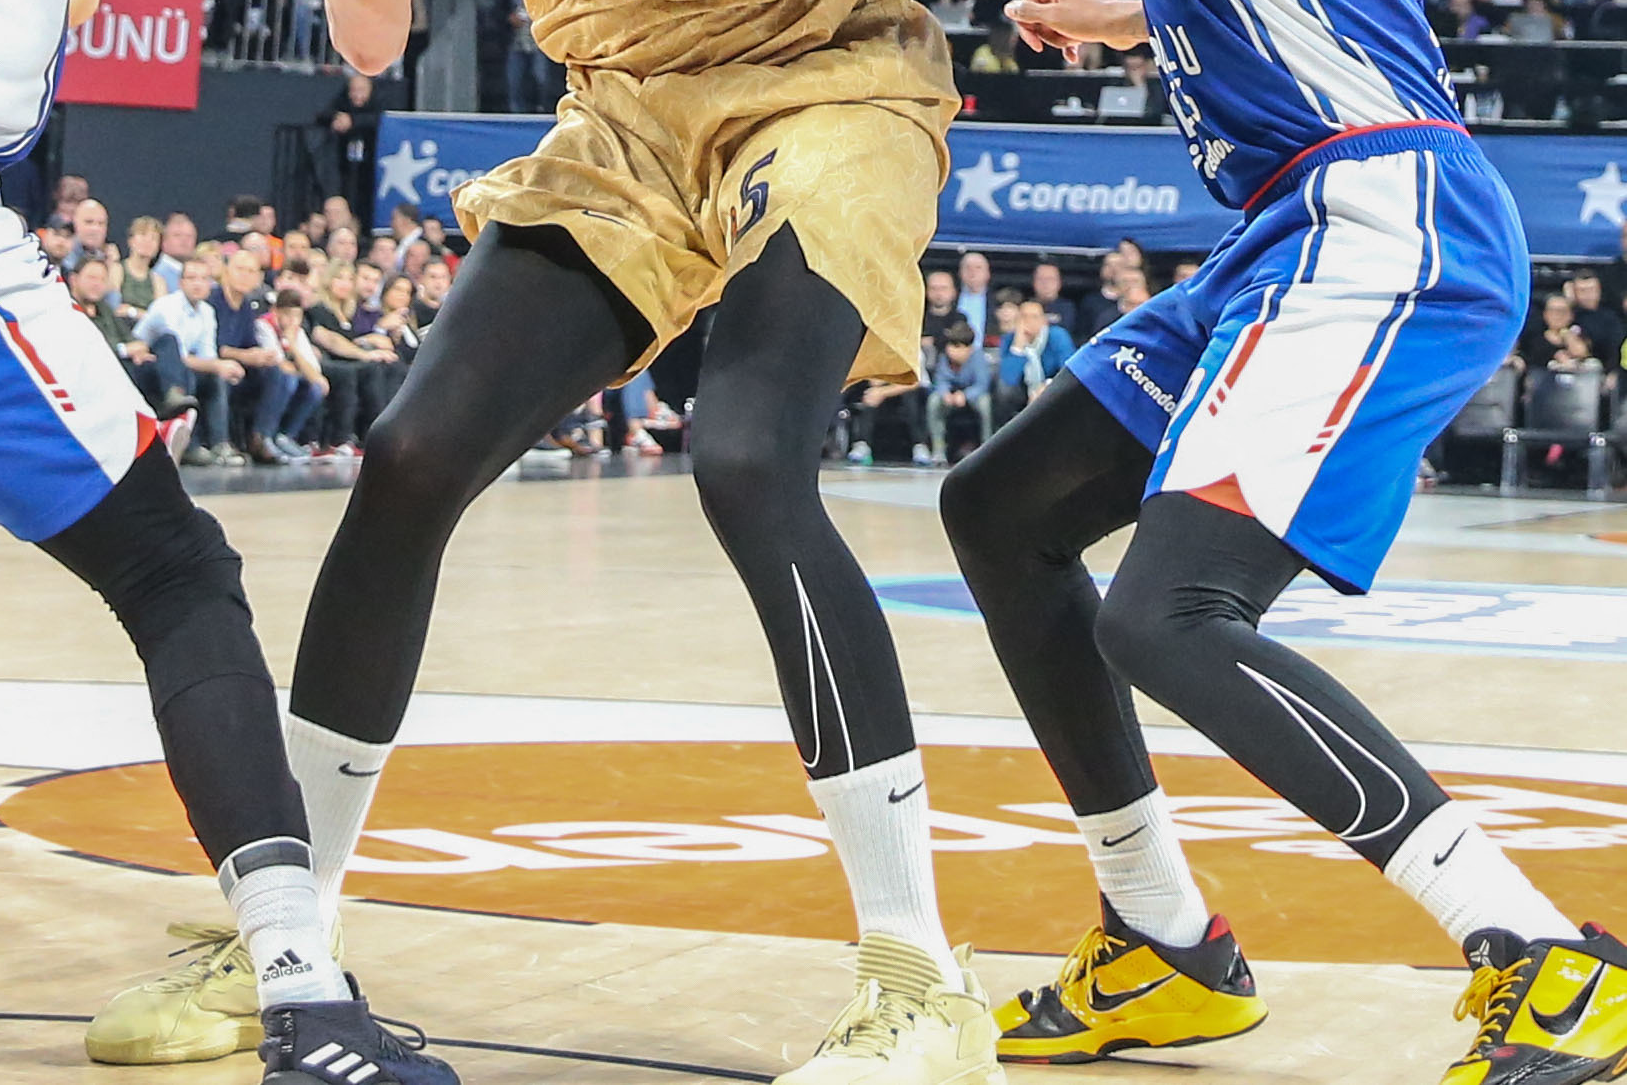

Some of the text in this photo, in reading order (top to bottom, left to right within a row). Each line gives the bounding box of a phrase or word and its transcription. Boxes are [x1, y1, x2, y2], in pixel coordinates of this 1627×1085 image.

[734, 146, 778, 245] 5
[1008, 176, 1180, 214] corendon
[1124, 363, 1178, 417] corendo
[261, 962, 313, 983] adidas
